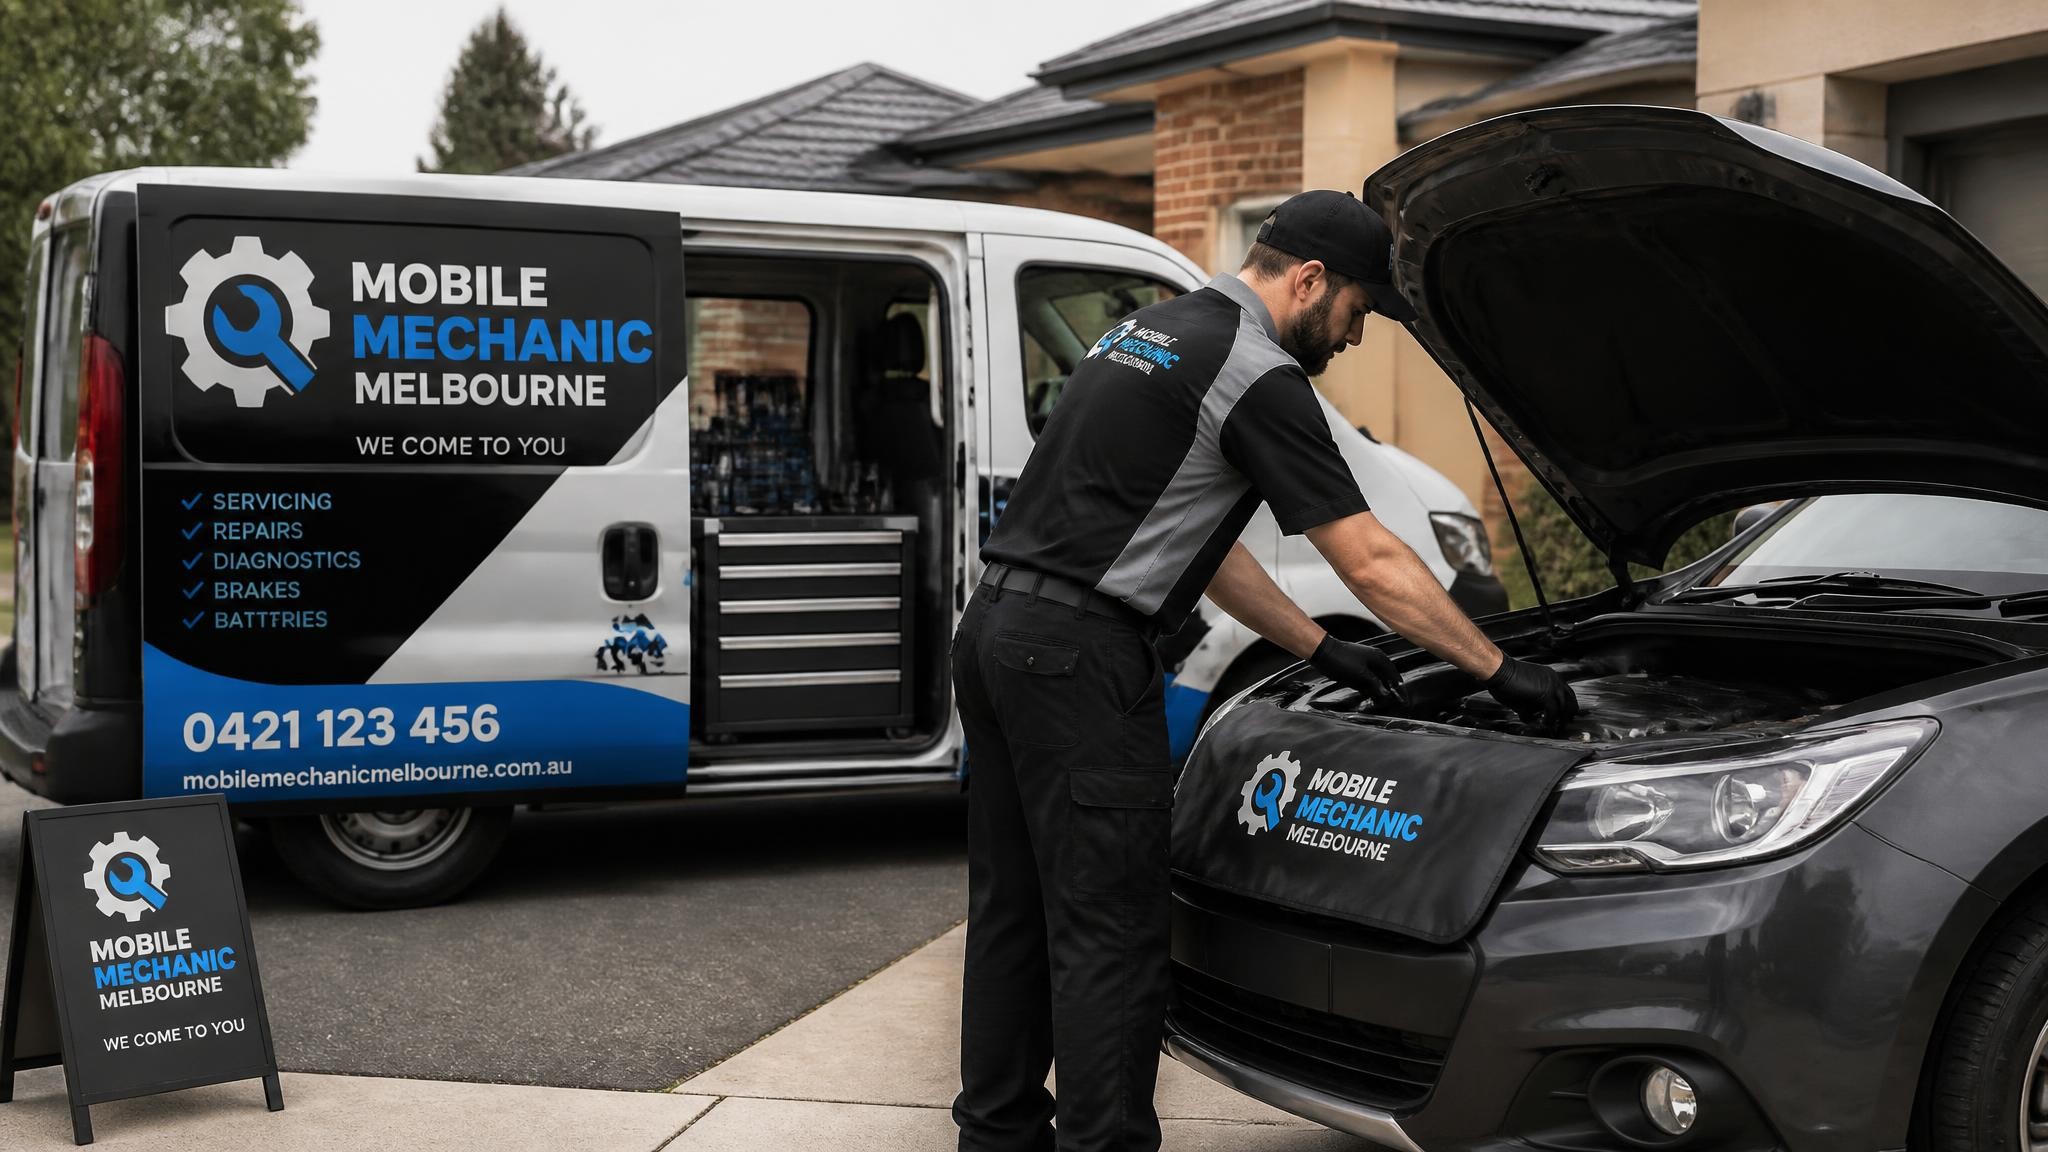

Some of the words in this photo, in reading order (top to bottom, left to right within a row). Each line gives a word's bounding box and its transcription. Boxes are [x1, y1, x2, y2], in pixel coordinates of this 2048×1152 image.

[352, 262, 548, 307] MOBILE
[353, 314, 653, 363] MECHANIC
[355, 372, 607, 407] MELBOURNE
[356, 436, 394, 455] WE
[402, 436, 473, 456] COME
[478, 437, 511, 456] TO
[517, 437, 566, 456] YOU
[213, 492, 332, 511] SERVICING
[213, 521, 303, 540] REPAIRS
[213, 551, 361, 570] DIAGNOSTICS
[214, 581, 301, 600] BRAKES
[183, 711, 300, 752] 0421
[317, 707, 396, 748] 123
[409, 704, 500, 745] 456
[183, 757, 573, 790] mobilemechanicmelbourne.com.au
[1307, 768, 1398, 804] MOBILE
[1295, 794, 1423, 842] MECHANIC
[1286, 823, 1391, 862] MELBOURNE
[89, 927, 192, 963] MOBILE
[94, 946, 236, 989] MECHANIC
[100, 976, 223, 1010] MELBOURNE
[103, 1035, 130, 1052] WE
[134, 1027, 182, 1047] COME
[185, 1024, 208, 1039] TO
[211, 1018, 245, 1036] YOU
